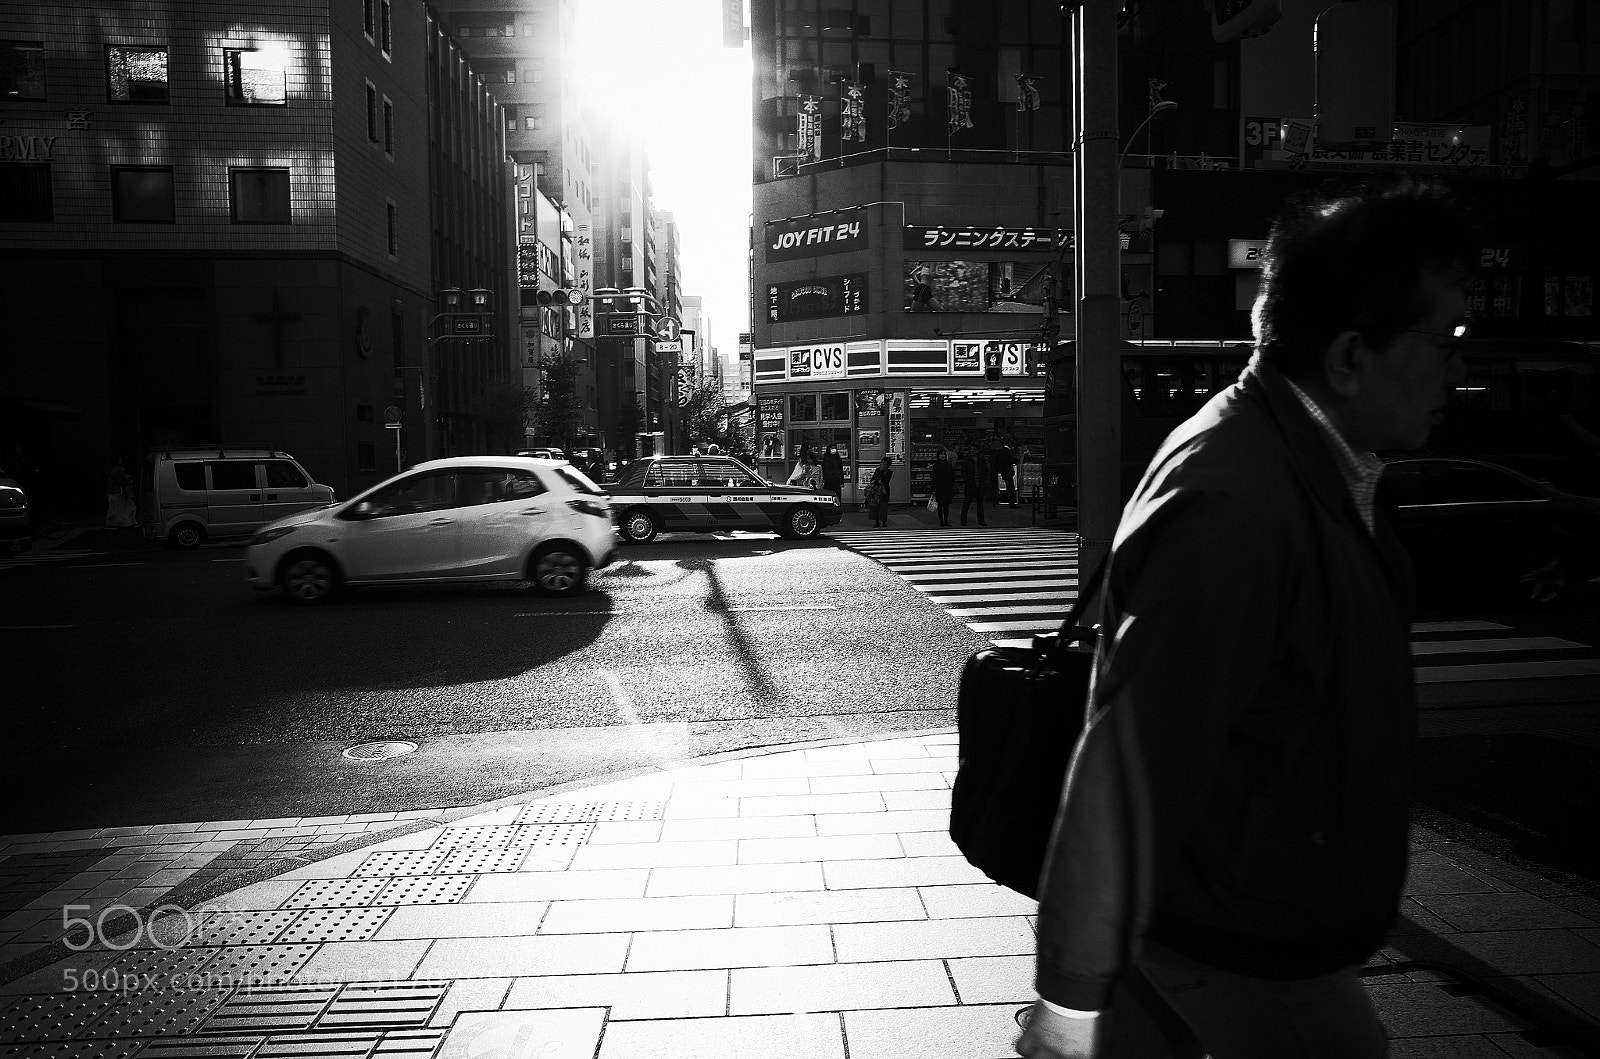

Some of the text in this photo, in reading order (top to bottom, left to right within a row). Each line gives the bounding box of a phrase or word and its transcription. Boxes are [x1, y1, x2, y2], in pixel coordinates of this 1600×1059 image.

[65, 107, 93, 131] 営
[1245, 121, 1278, 146] 3F
[520, 166, 533, 233] レコード
[772, 221, 860, 250] JOY FIT 24
[1480, 248, 1512, 268] 24
[813, 347, 842, 370] CVS
